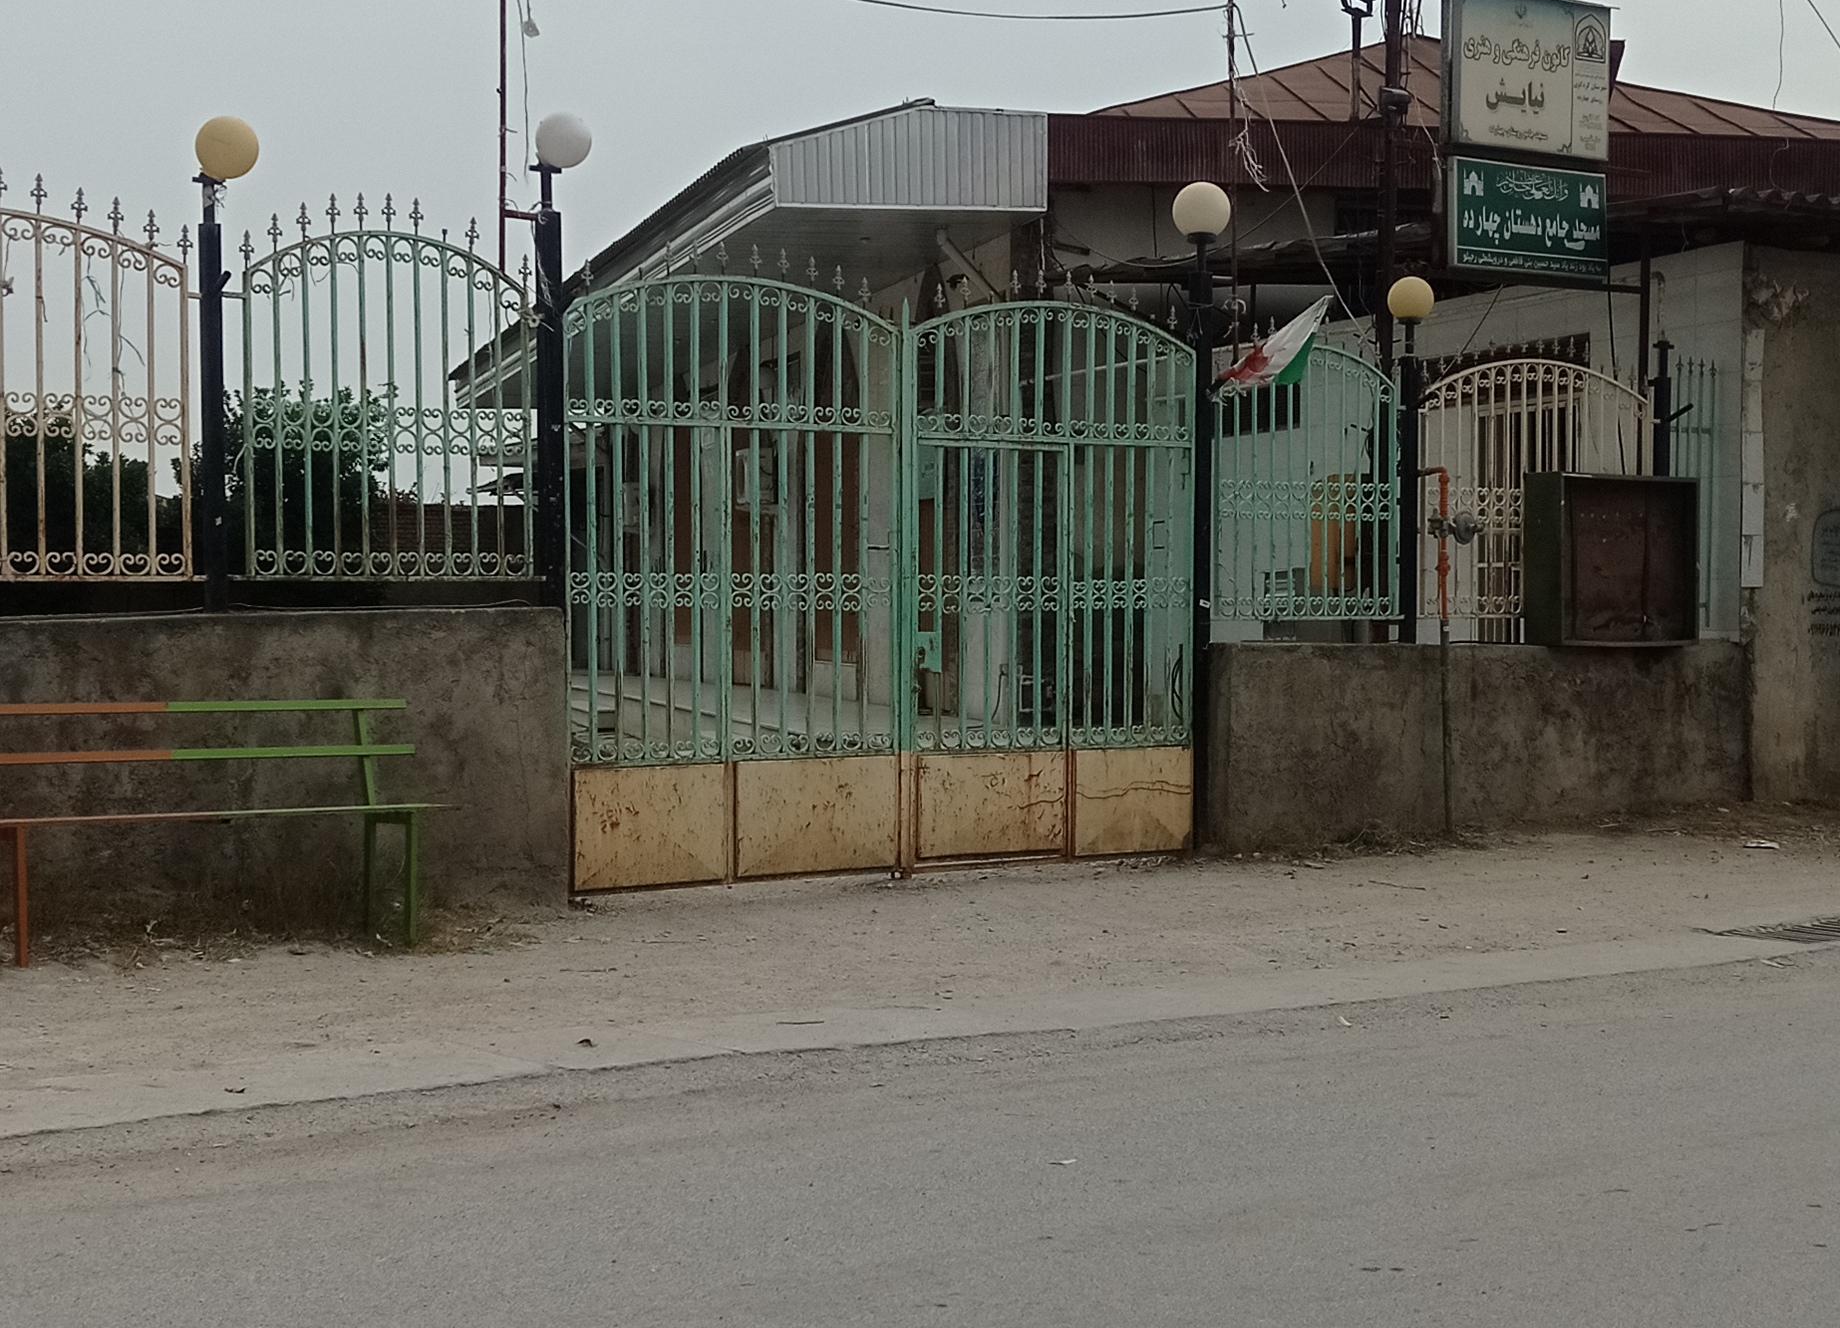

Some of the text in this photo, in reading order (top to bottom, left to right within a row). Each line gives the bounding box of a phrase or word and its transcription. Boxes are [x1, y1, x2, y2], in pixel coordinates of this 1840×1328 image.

[1463, 35, 1570, 73] کانون فرهنگی و هنری
[1486, 77, 1545, 115] نیایش
[1504, 208, 1542, 240] دهستان
[1545, 213, 1569, 247] جامع
